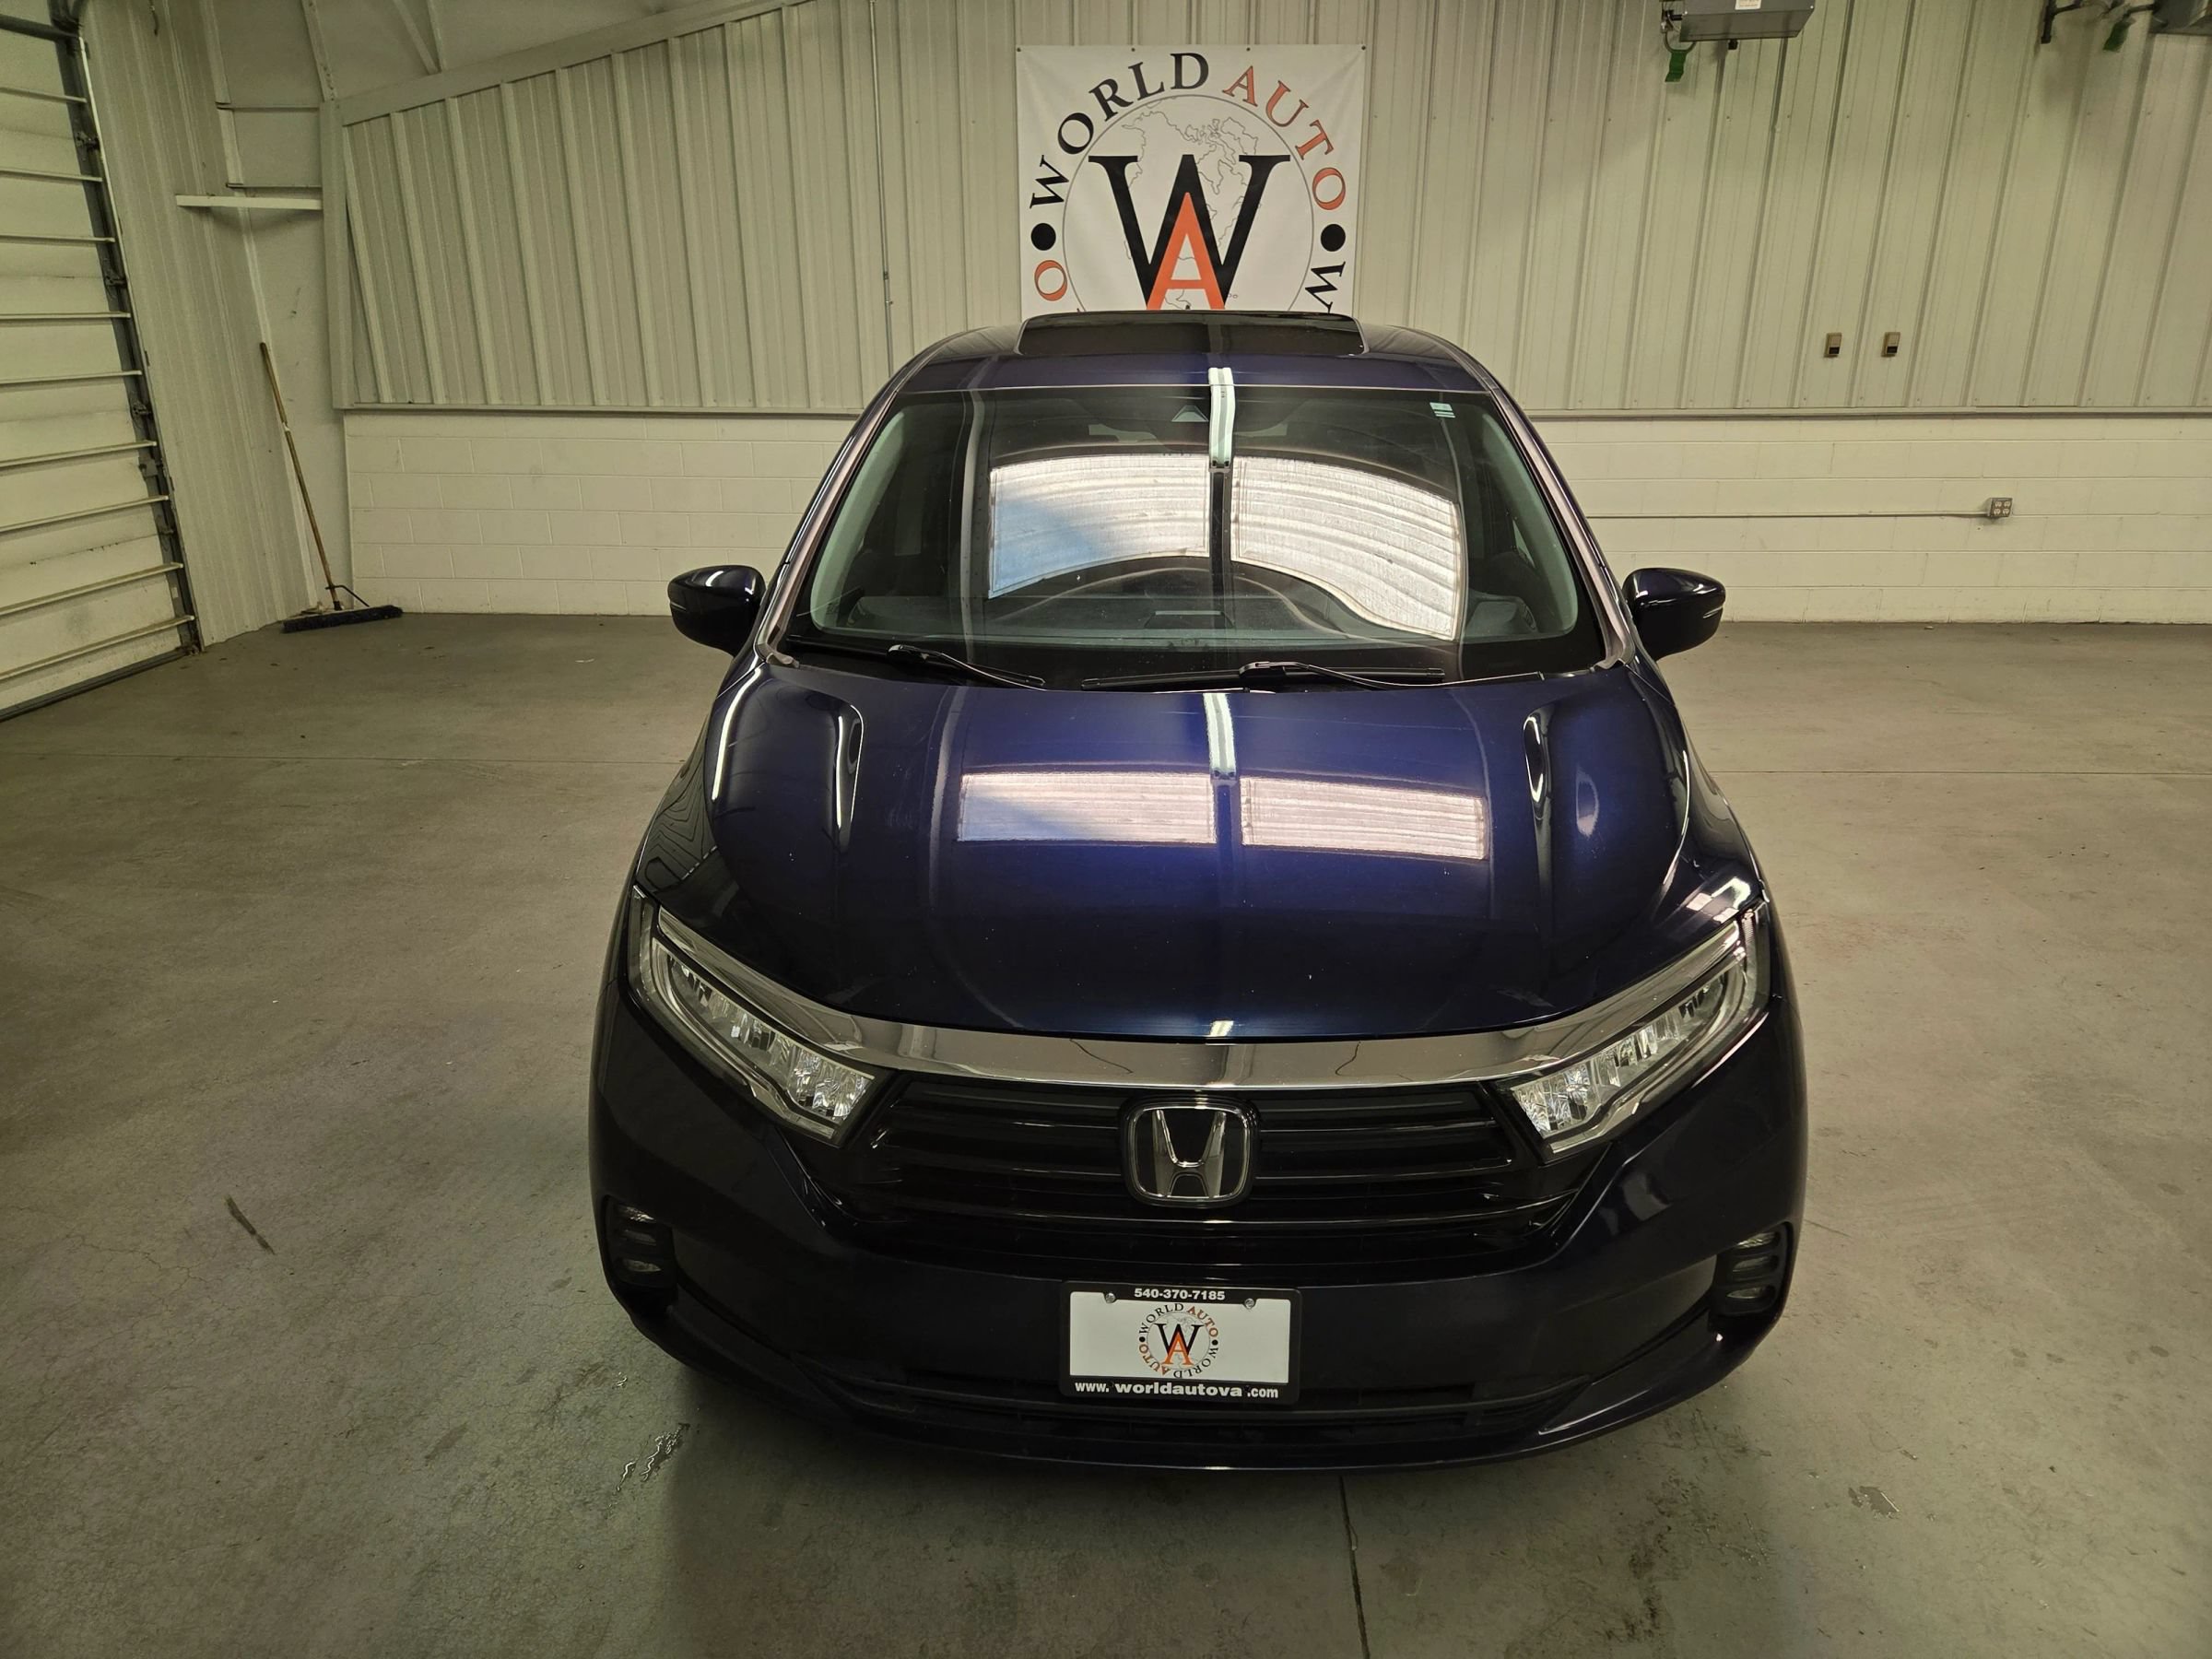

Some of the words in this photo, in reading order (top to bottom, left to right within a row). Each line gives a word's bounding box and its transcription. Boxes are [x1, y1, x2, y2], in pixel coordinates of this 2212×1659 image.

[1030, 53, 1209, 208] WORLD
[1222, 65, 1347, 210] AUTO
[1134, 1288, 1226, 1300] 540-370-7185
[1139, 1302, 1184, 1334] WORLD
[1186, 1306, 1218, 1337] AUTO
[1138, 1344, 1171, 1375] AUTO
[1173, 1347, 1218, 1379] WORLD
